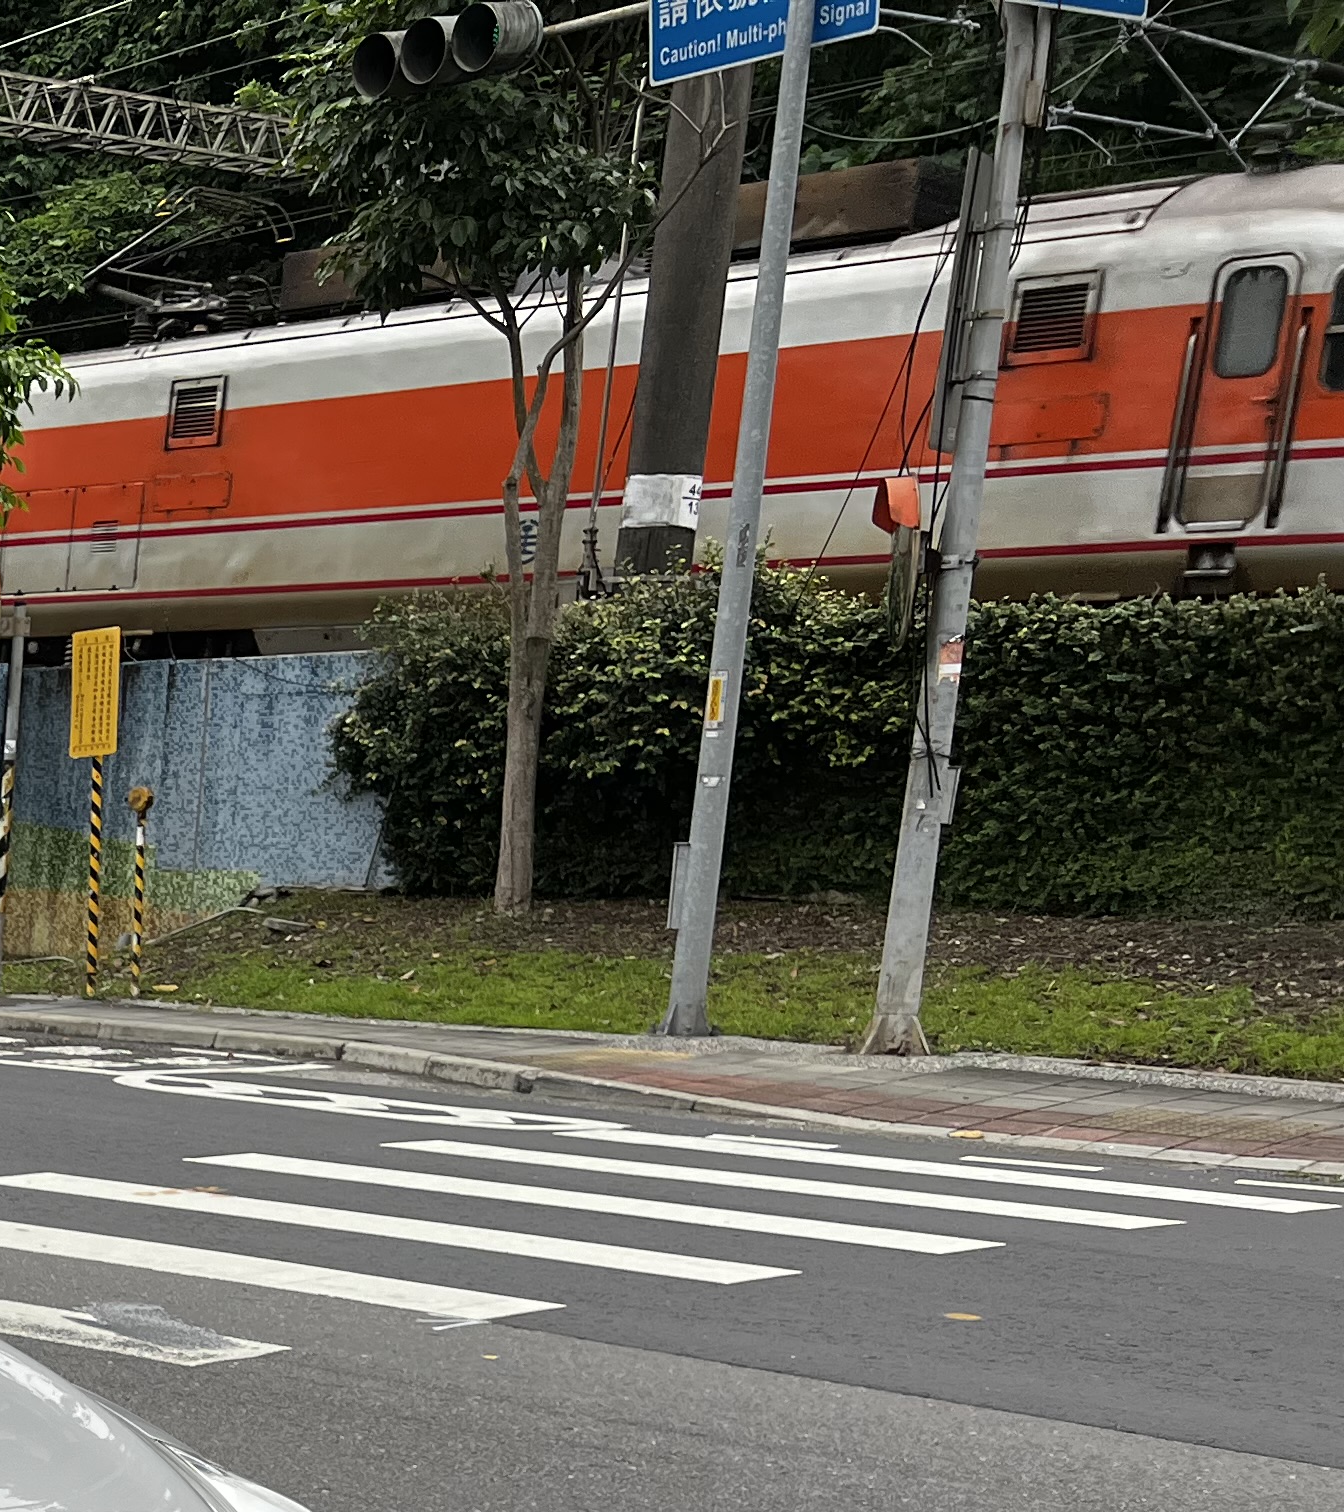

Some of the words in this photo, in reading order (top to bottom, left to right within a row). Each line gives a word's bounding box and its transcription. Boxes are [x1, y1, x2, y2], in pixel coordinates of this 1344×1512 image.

[659, 33, 721, 66] Caution!
[726, 17, 787, 49] Multi-ph
[819, 0, 870, 26] Signal
